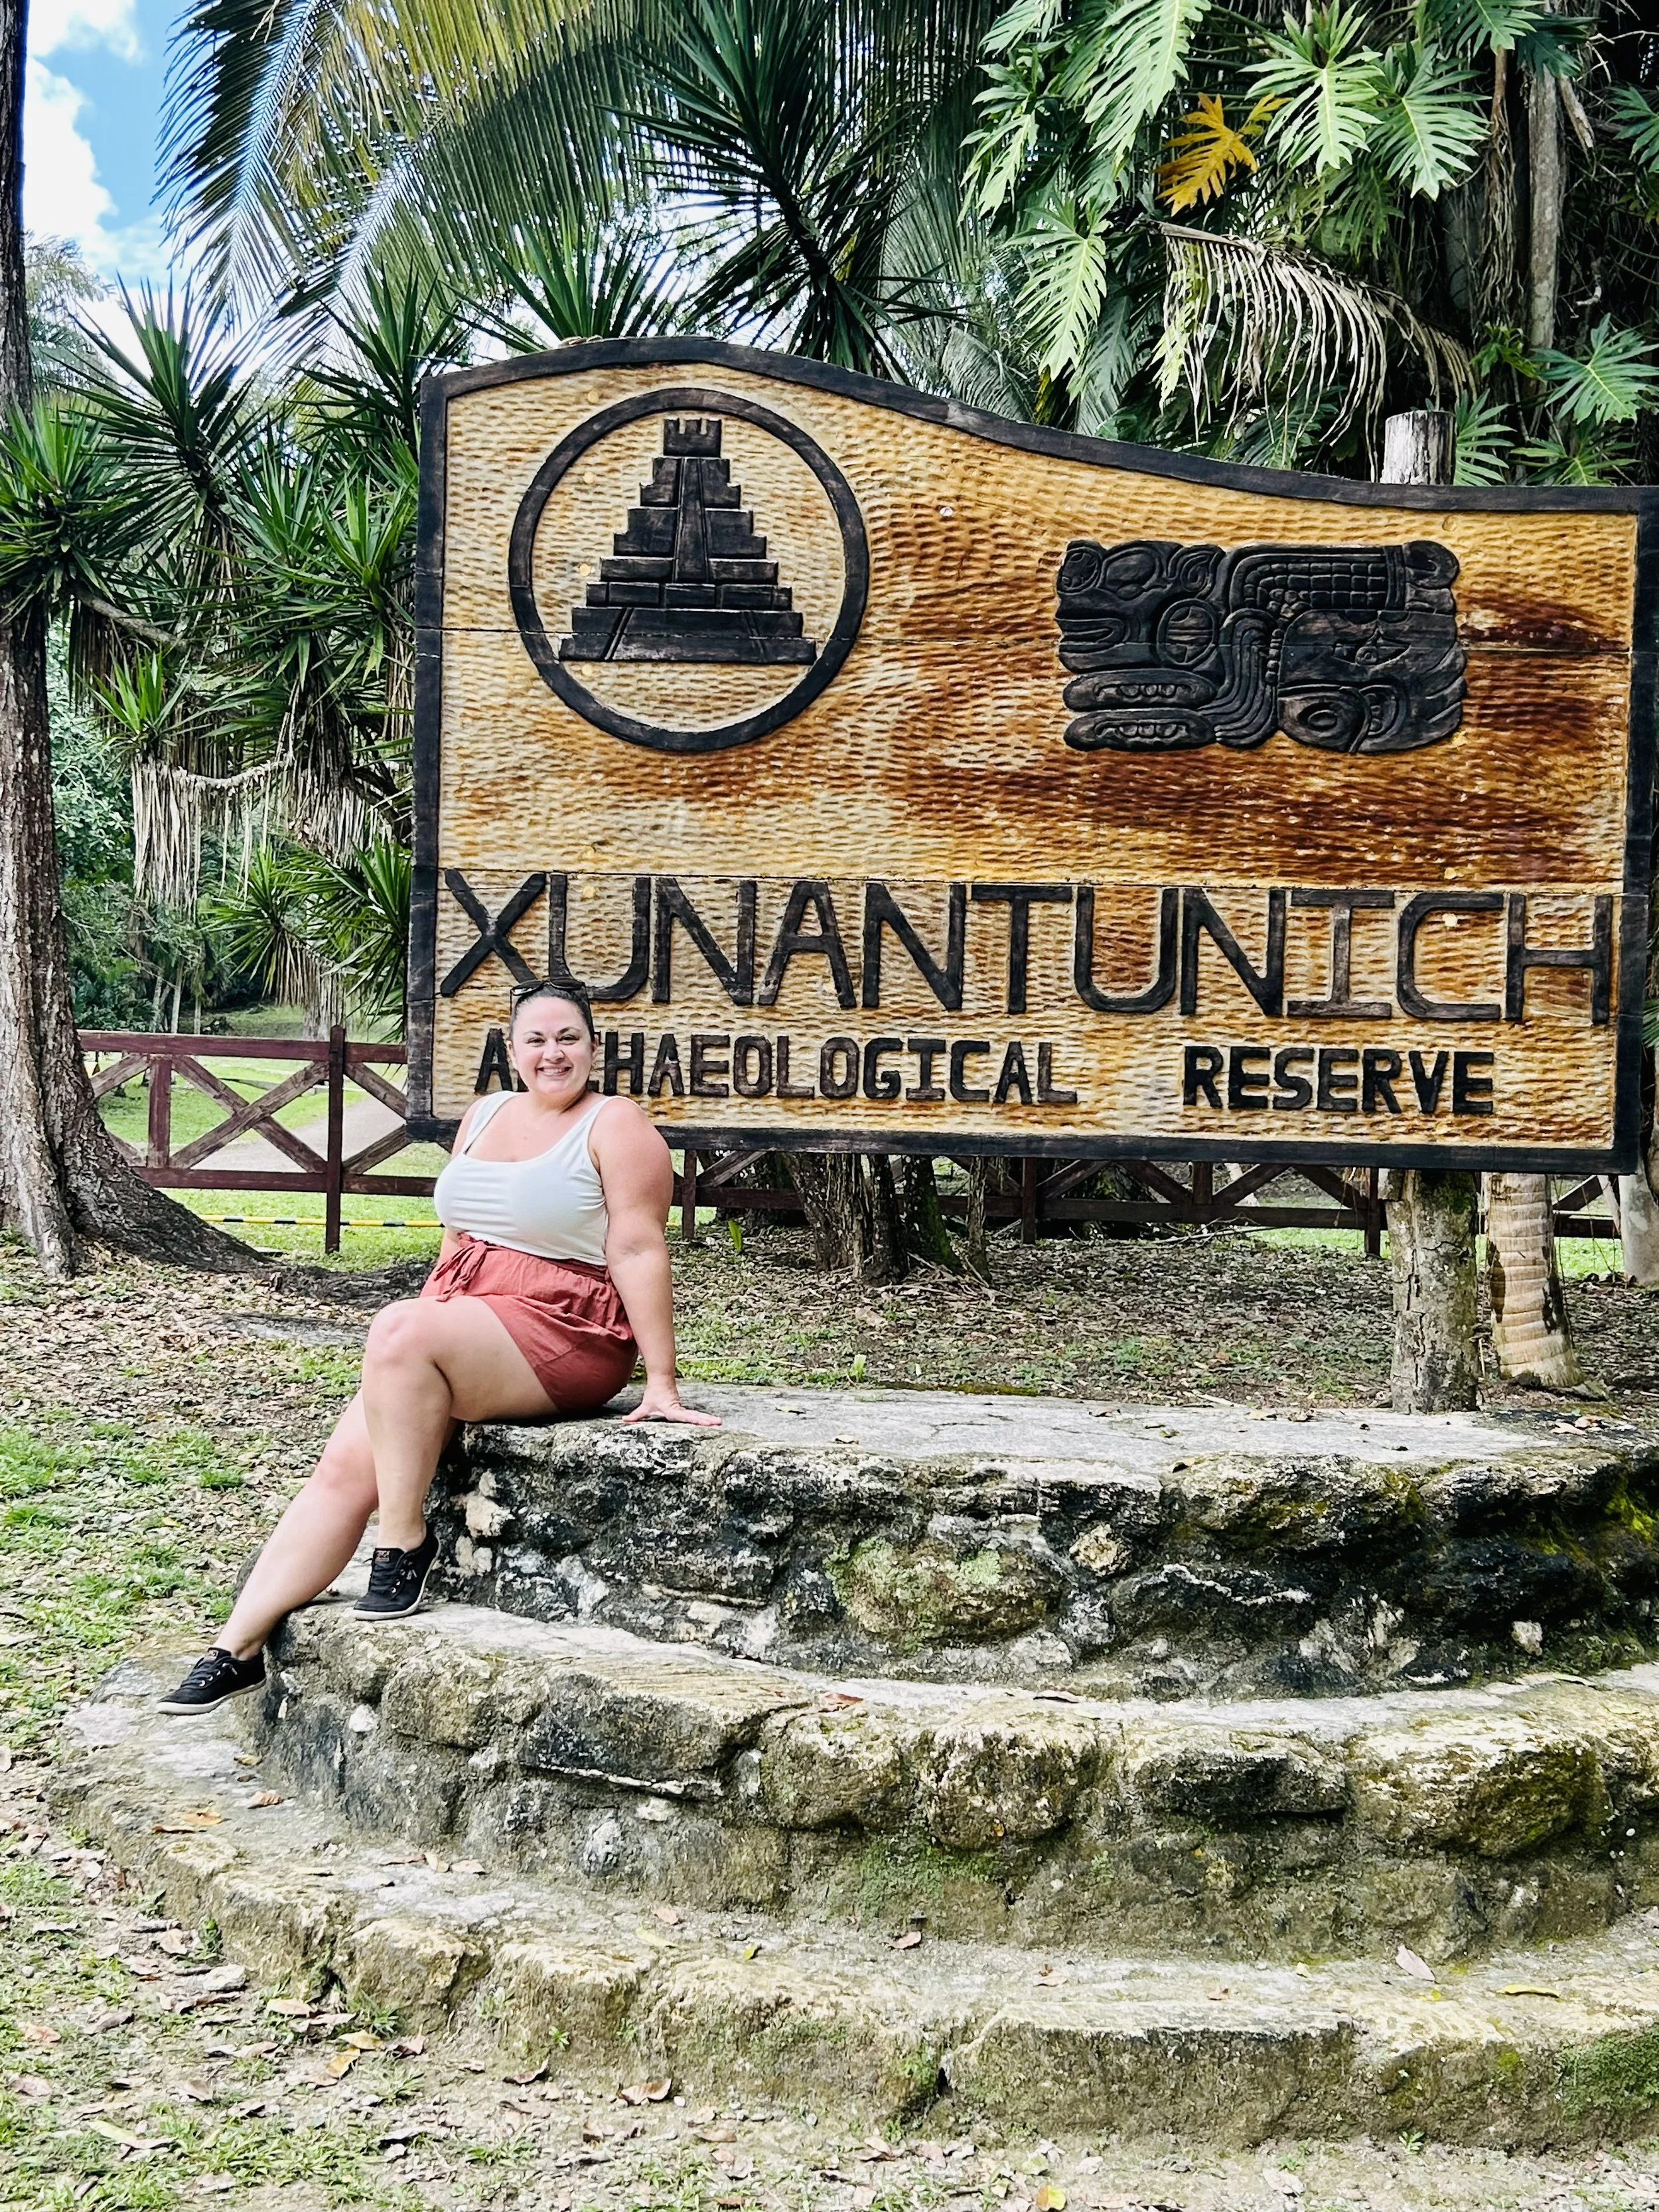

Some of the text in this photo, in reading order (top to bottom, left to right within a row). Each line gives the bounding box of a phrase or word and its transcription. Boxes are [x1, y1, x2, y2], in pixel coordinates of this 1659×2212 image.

[441, 869, 1613, 1025] XUNANTUNICH
[474, 1028, 1494, 1115] AHAEOLOGICAL RESERVE
